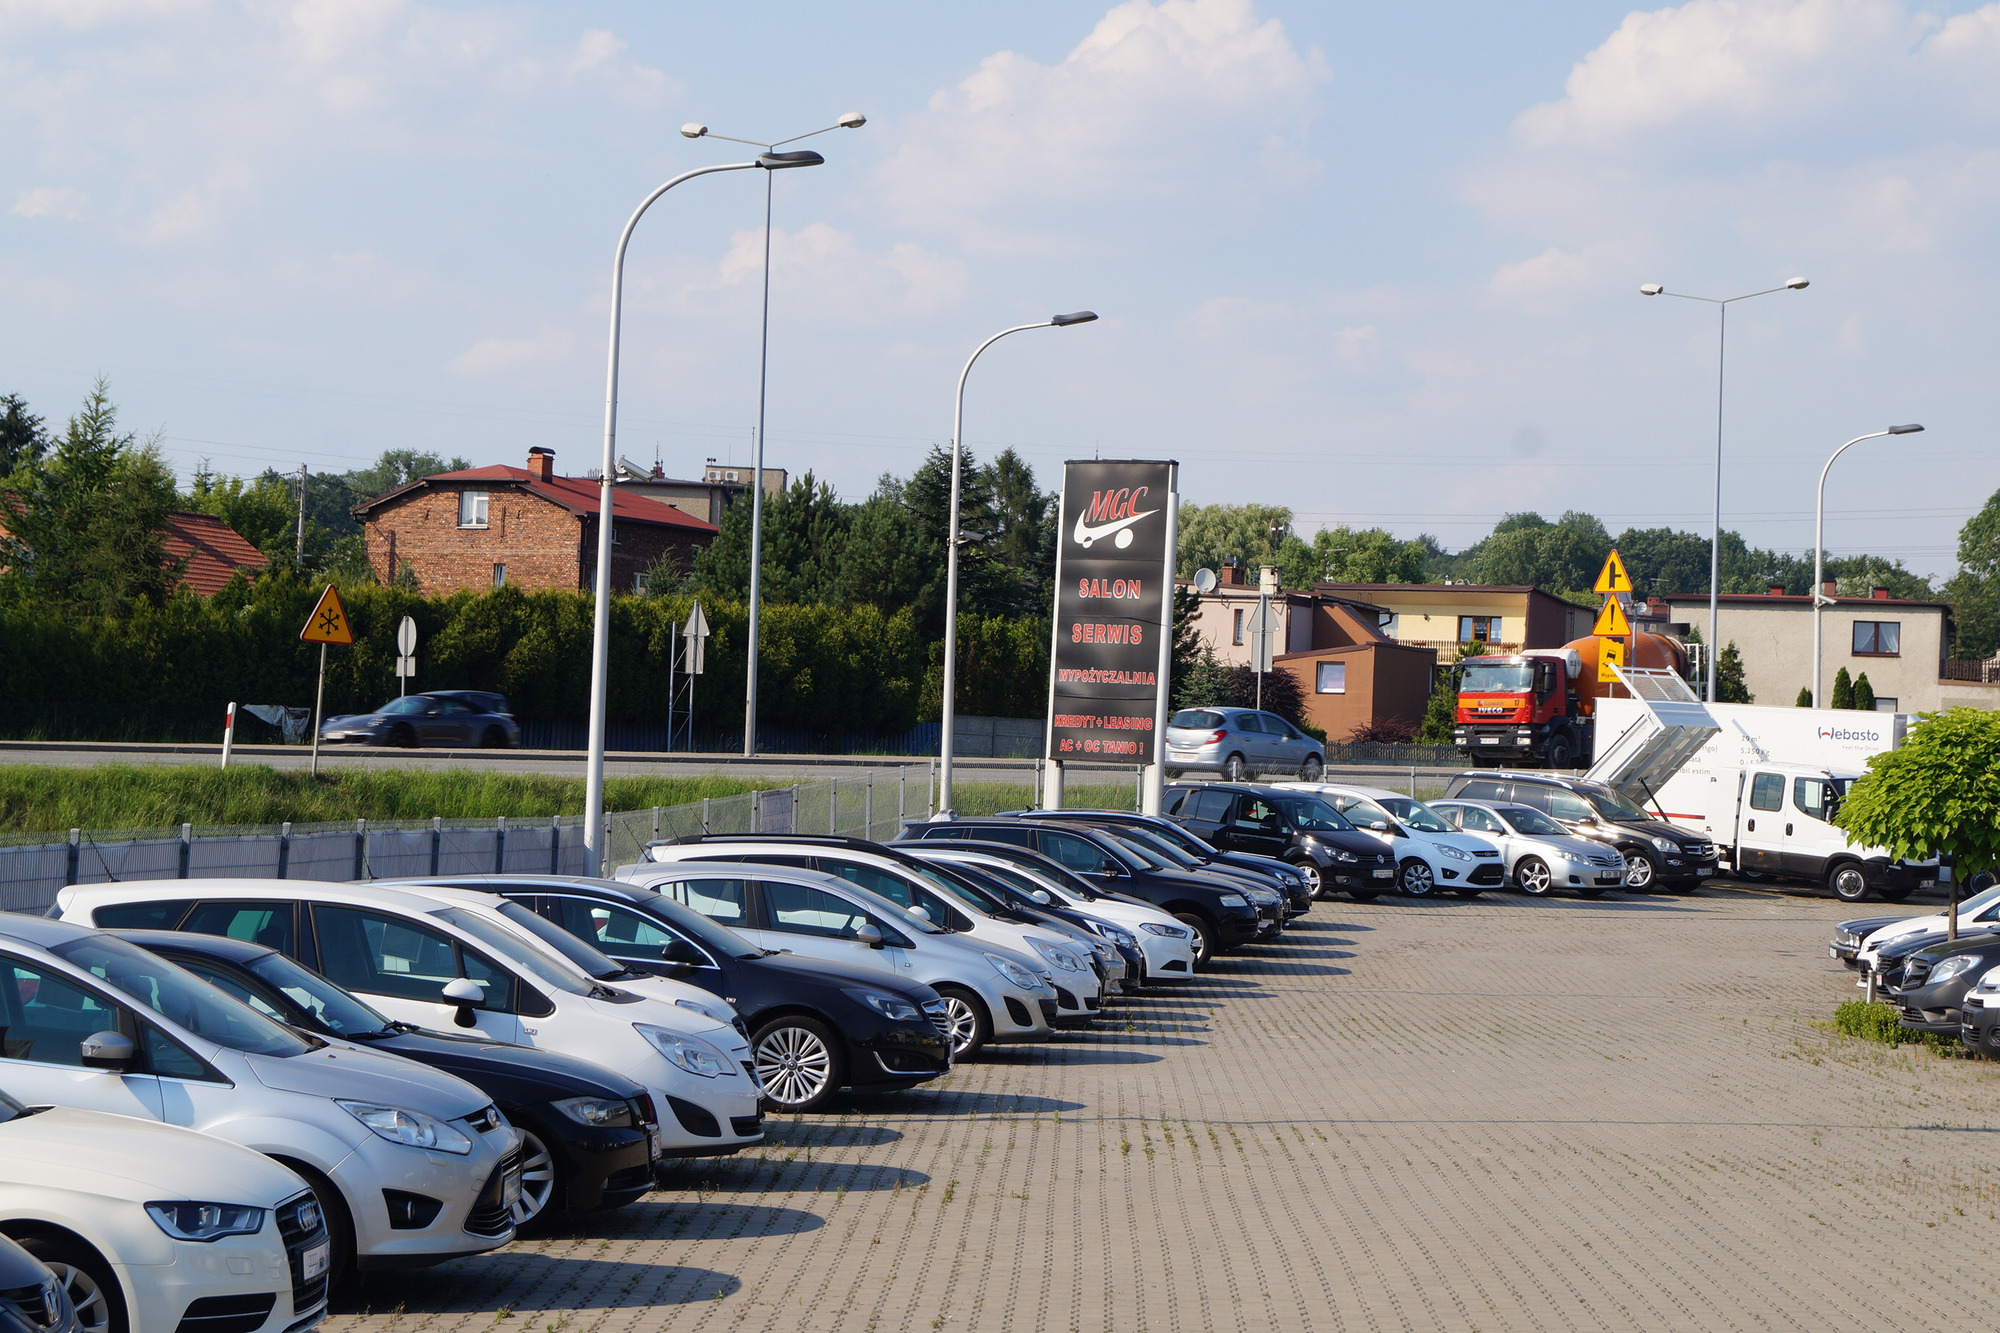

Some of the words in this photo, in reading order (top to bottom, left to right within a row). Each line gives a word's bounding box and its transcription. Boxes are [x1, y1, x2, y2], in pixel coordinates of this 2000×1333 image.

[1085, 486, 1149, 522] MGC
[1079, 578, 1141, 599] SALON
[1072, 623, 1142, 645] SERWIS
[1058, 667, 1156, 685] WYPOŻYCZALNIA
[1054, 714, 1095, 729] KREDYT
[1103, 716, 1153, 731] LEASING
[1818, 726, 1879, 741] Webasto
[1059, 739, 1074, 752] AC
[1075, 741, 1082, 750] +
[1083, 740, 1100, 753] OC
[1102, 741, 1137, 754] TANIO
[1700, 745, 1718, 753] rigo)
